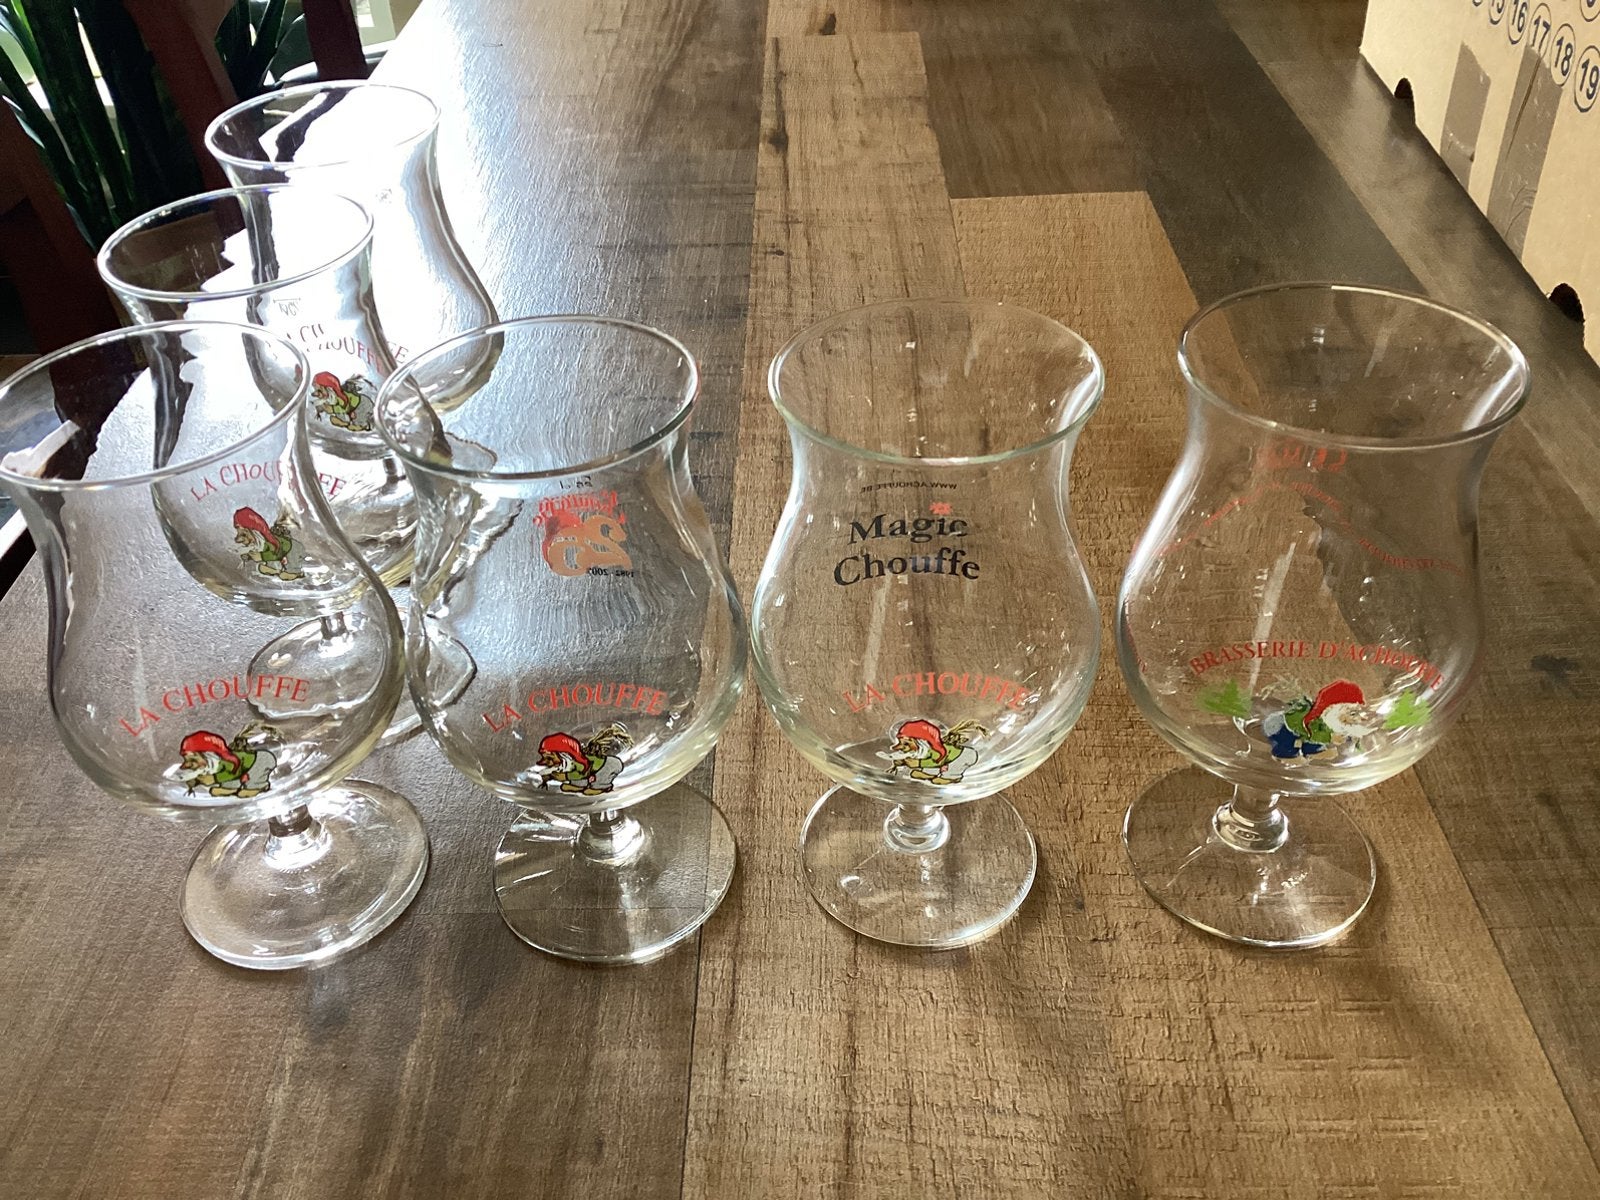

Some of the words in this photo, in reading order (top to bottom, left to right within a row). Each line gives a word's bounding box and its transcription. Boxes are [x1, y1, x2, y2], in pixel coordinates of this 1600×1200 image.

[1511, 0, 1527, 33] 16
[1531, 15, 1550, 53] 17
[1554, 36, 1573, 77] 18
[1580, 58, 1600, 100] 19
[191, 477, 217, 501] LA
[847, 513, 968, 544] Magic
[833, 547, 981, 586] Chouffe
[1188, 639, 1313, 676] BRASSERIE
[119, 706, 161, 737] LA
[162, 673, 311, 713] CHOUFFE
[482, 702, 522, 733] LA
[527, 680, 668, 716] CHOUFFE
[842, 683, 886, 713] LA
[892, 670, 1033, 712] CHOUFFE
